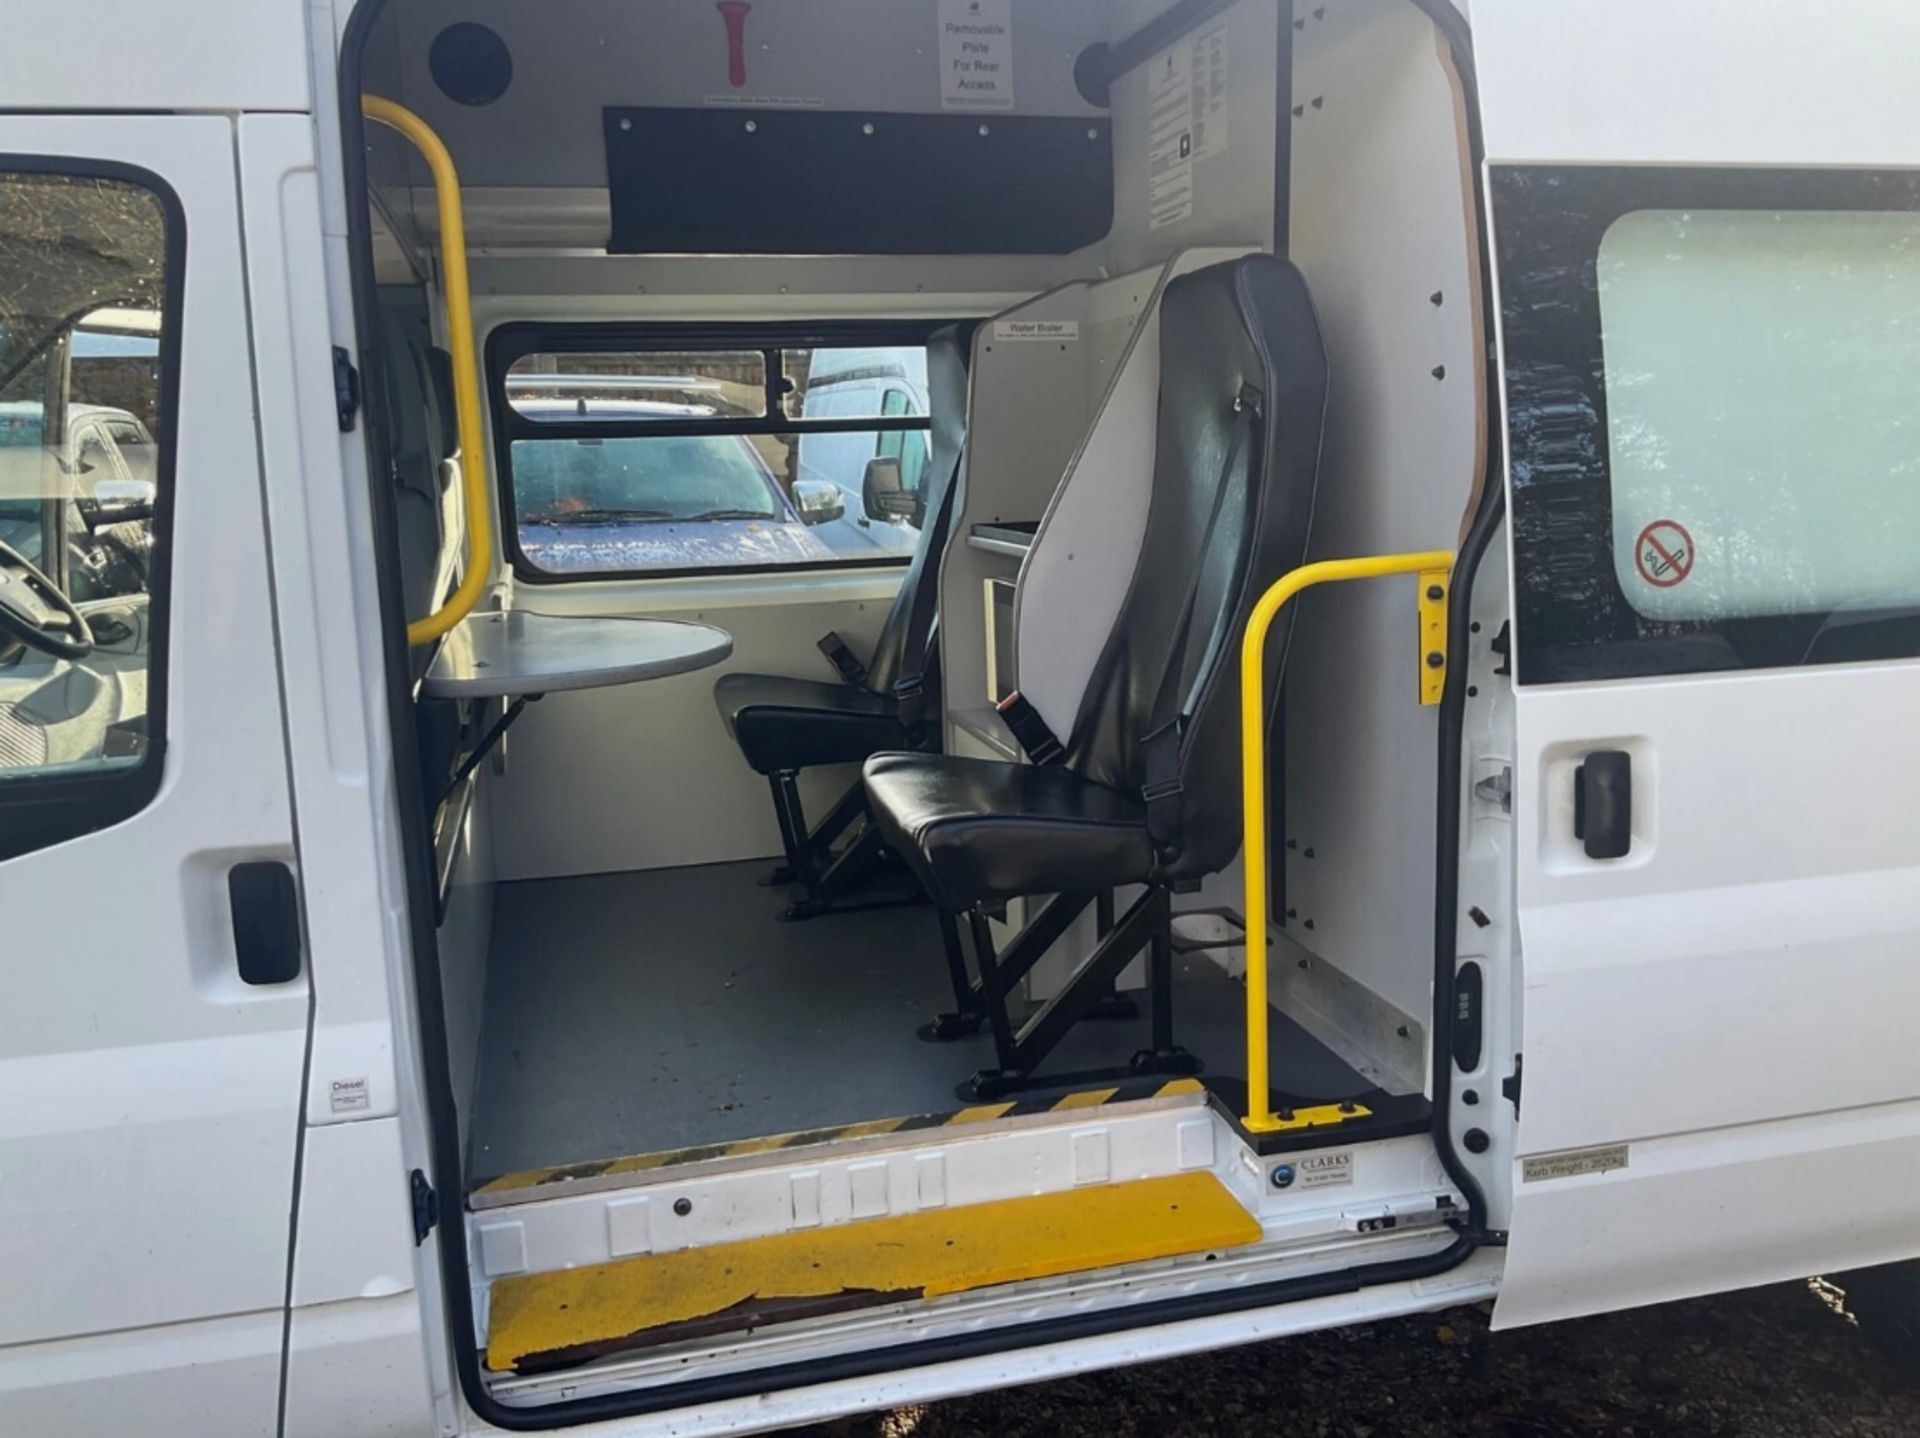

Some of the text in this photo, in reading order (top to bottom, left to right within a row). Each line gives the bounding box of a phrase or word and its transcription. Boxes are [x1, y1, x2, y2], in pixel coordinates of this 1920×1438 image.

[945, 22, 1004, 35] Removable
[962, 41, 989, 53] Plate
[953, 60, 999, 72] For Rear
[958, 79, 996, 91] Access
[1009, 323, 1064, 332] Water Boiler
[332, 1079, 365, 1091] Diesel
[1301, 1155, 1350, 1170] CLARKS
[1525, 1167, 1549, 1178] Kerb
[1550, 1161, 1583, 1175] Weight
